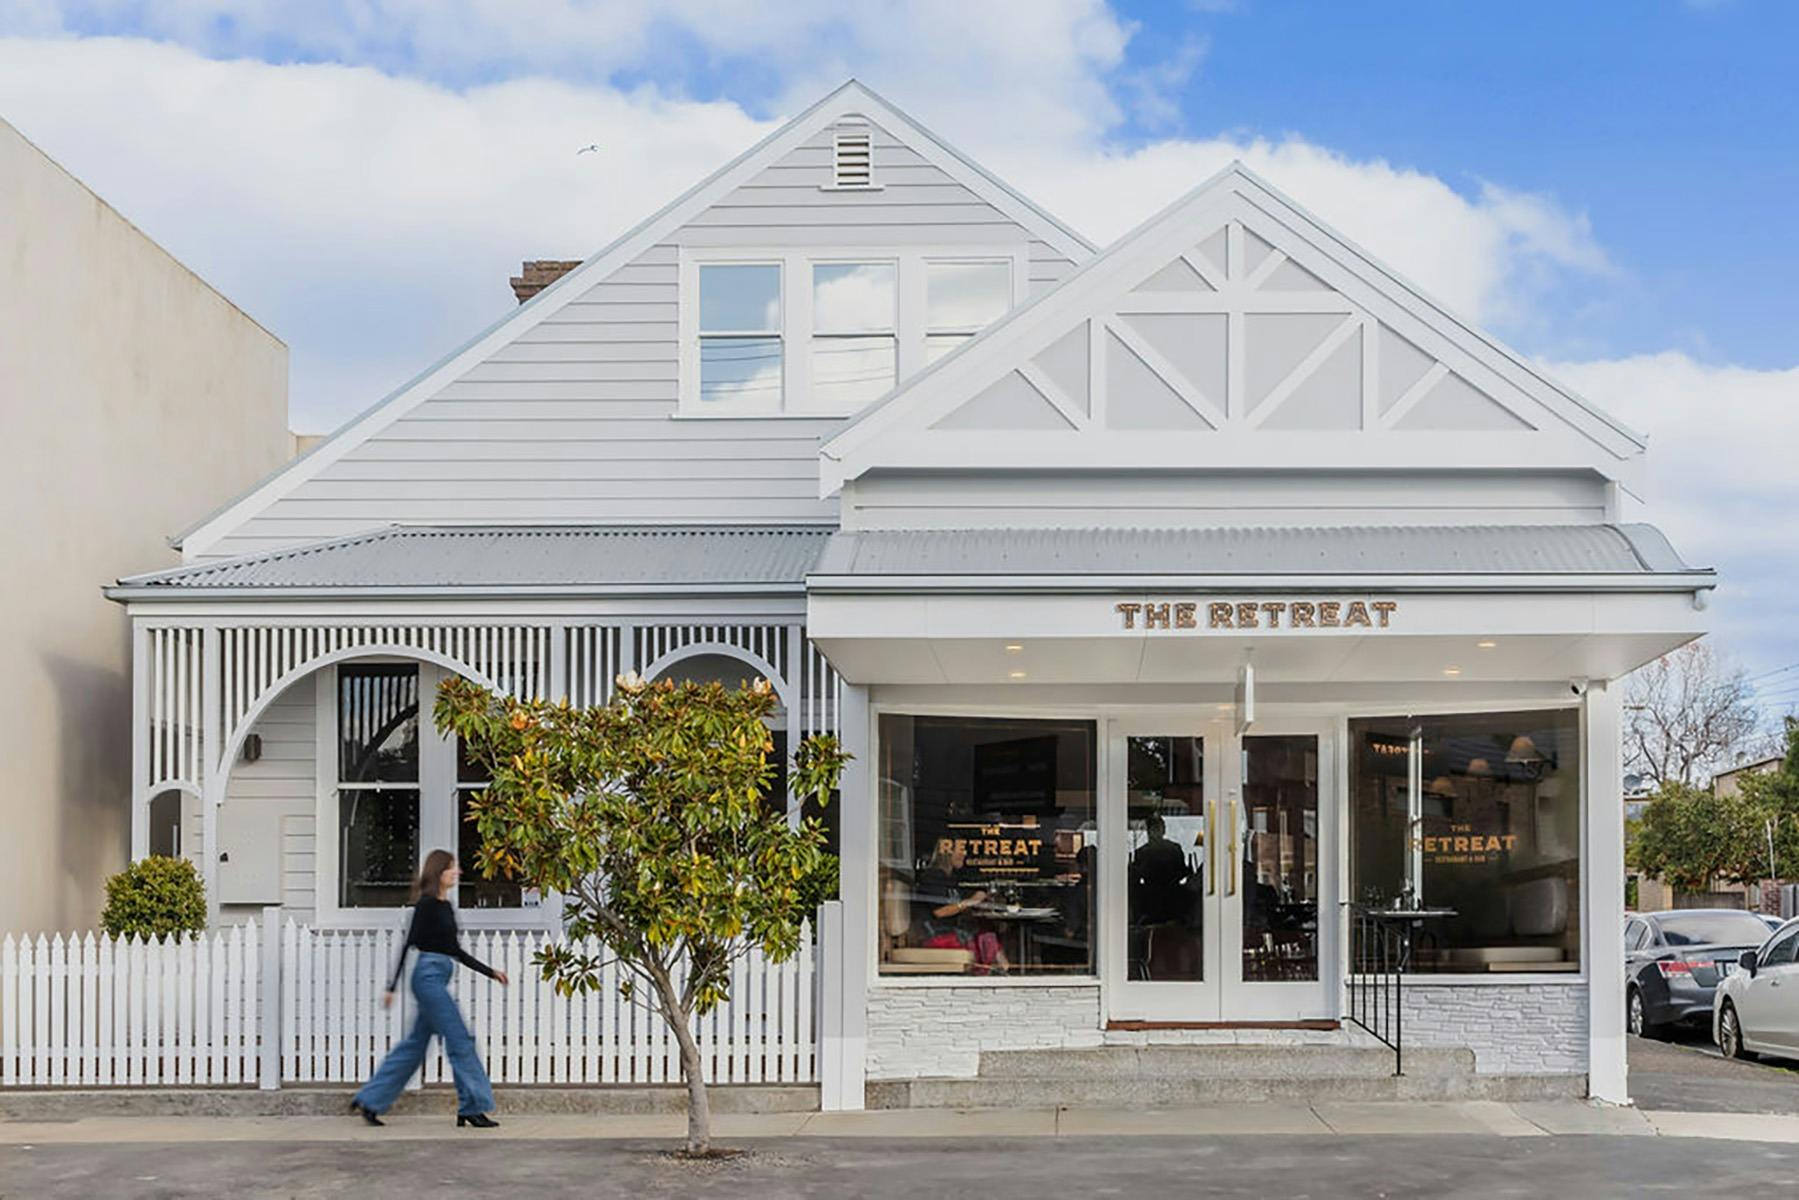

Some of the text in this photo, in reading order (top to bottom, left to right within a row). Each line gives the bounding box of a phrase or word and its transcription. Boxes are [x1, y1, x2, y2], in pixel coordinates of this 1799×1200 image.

[1117, 601, 1397, 629] THE RETREAT
[981, 827, 1001, 836] THE
[1450, 824, 1472, 833] THE
[938, 839, 1042, 856] RETREAT
